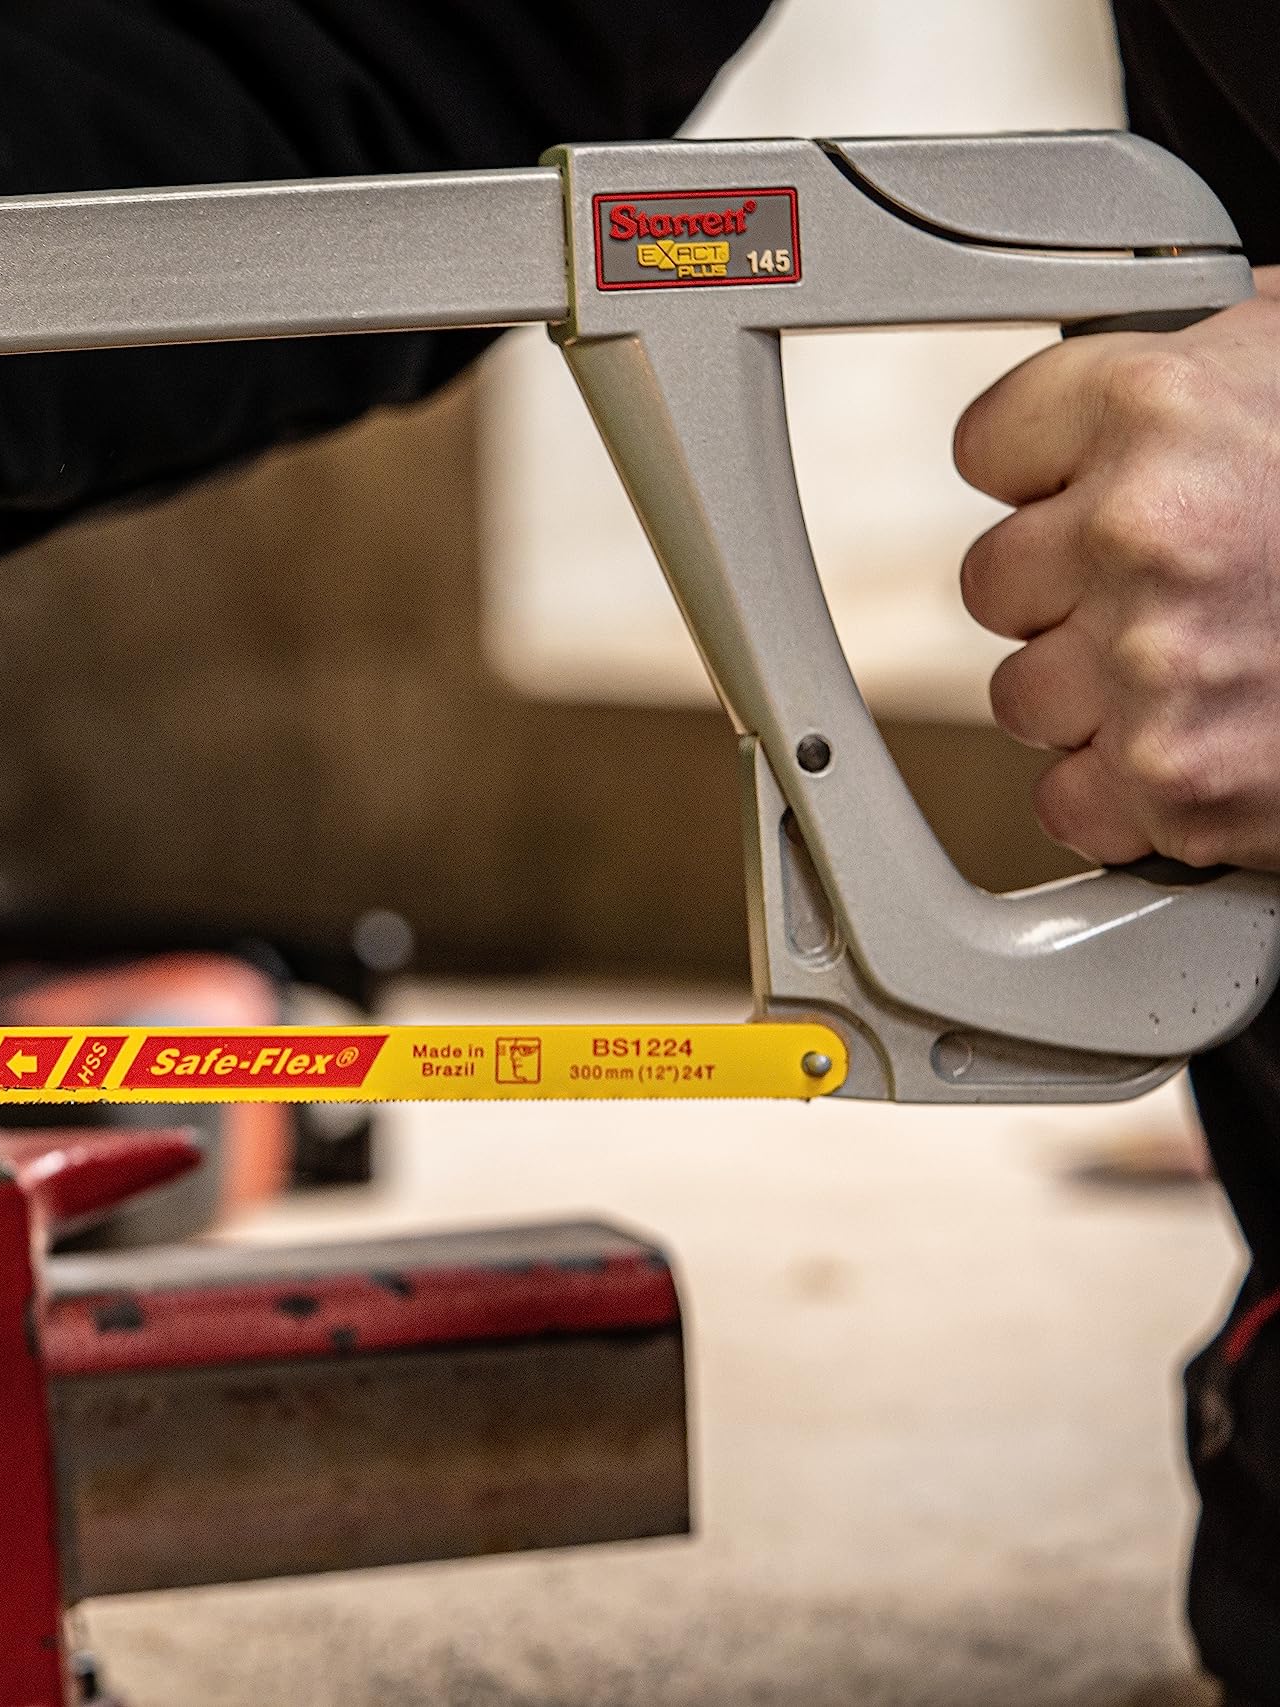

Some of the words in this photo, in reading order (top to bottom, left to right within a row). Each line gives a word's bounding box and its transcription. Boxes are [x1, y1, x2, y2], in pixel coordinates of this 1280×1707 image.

[638, 241, 723, 268] EXACT
[747, 249, 790, 273] 145
[677, 264, 727, 278] PLUS
[412, 1045, 462, 1058] Made
[468, 1044, 484, 1058] in
[592, 1038, 693, 1057] BS1224
[78, 1042, 107, 1084] HSS
[422, 1062, 475, 1077] Brazil
[570, 1065, 633, 1080] 300mm
